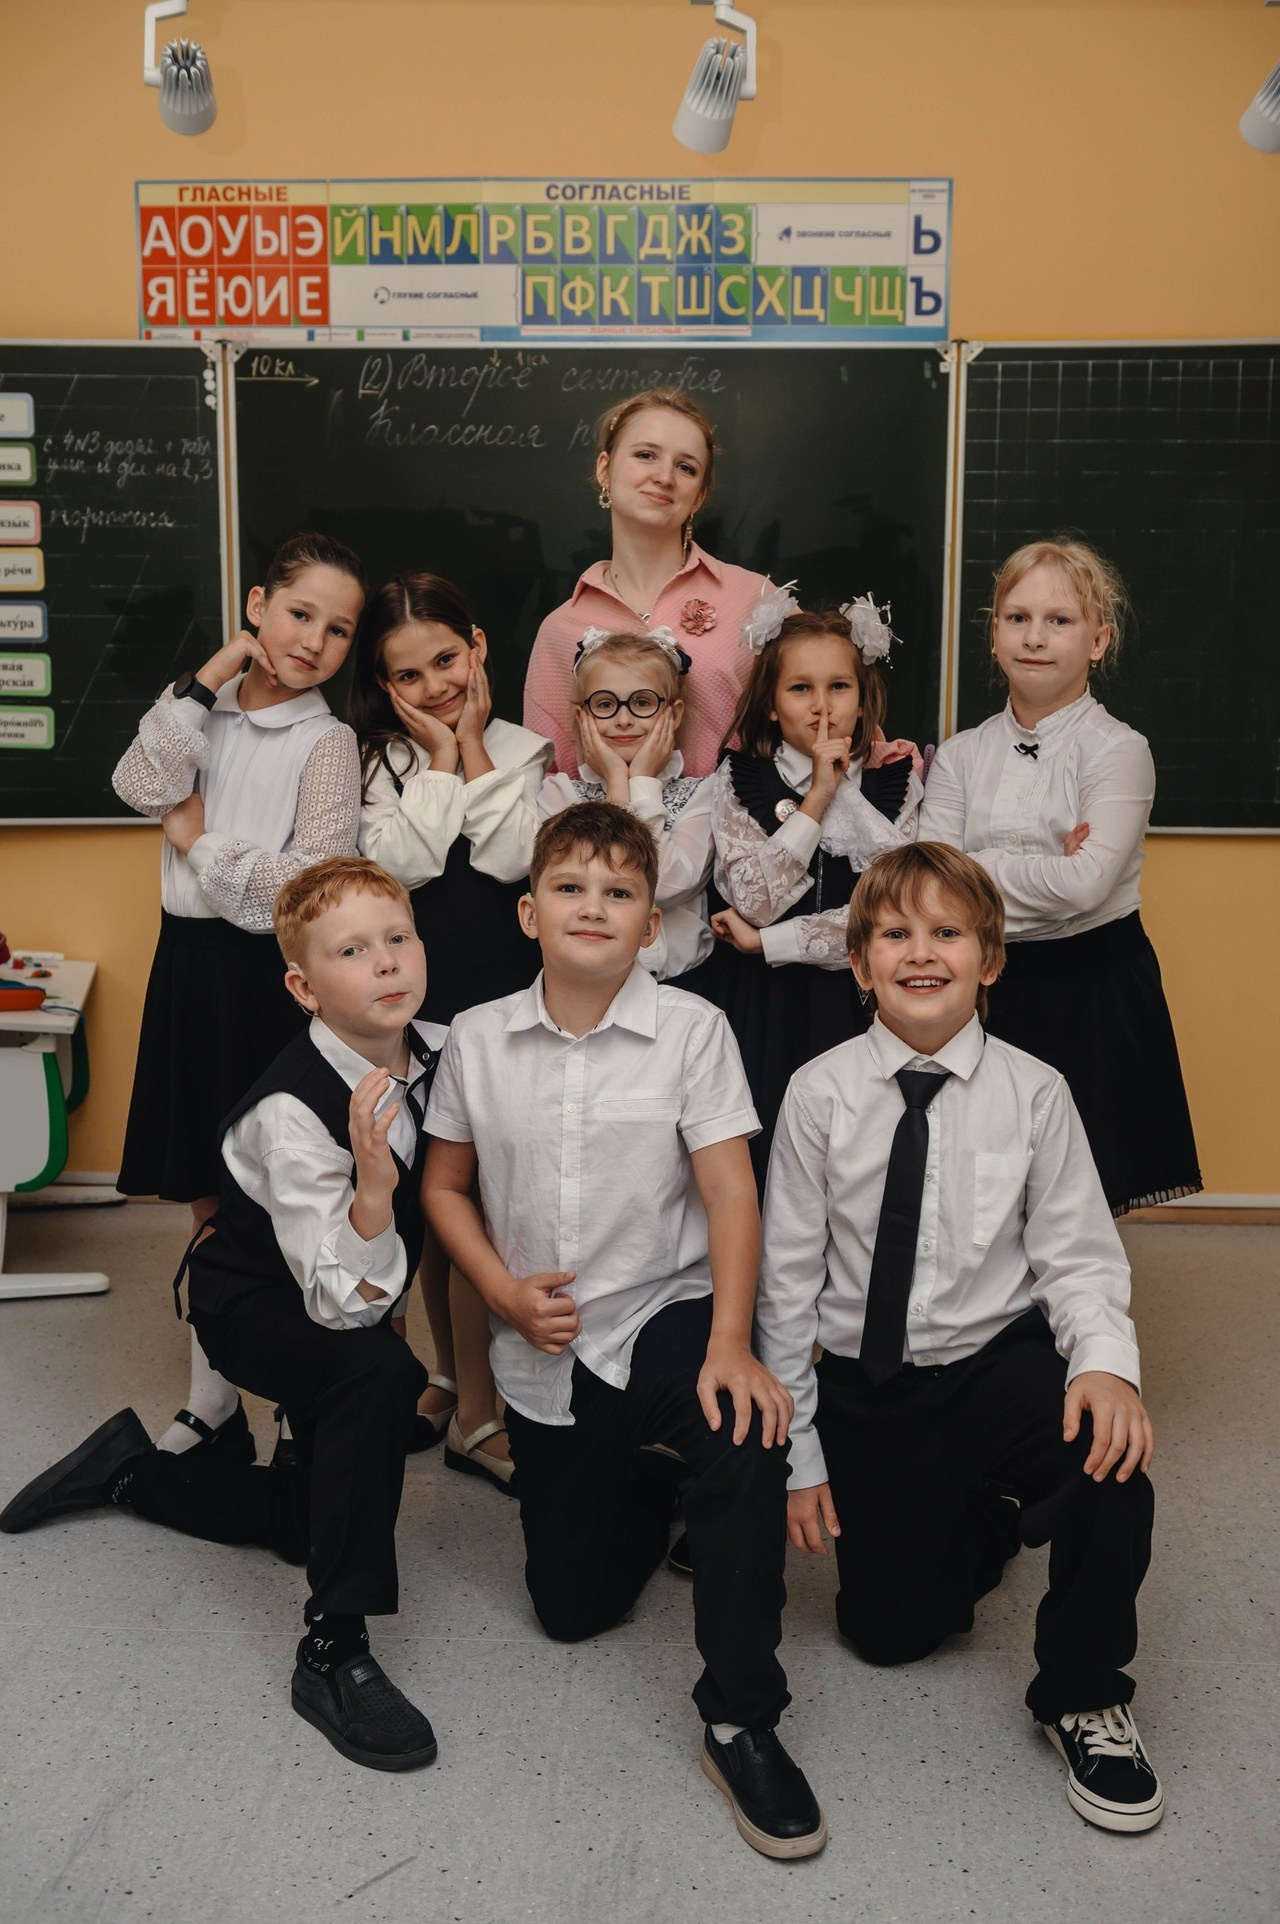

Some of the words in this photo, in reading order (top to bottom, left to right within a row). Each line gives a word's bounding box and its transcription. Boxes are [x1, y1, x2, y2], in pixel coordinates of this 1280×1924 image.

[177, 185, 289, 203] ГЛАСНЫЕ
[545, 183, 691, 201] СОГЛАСНЫЕ
[142, 215, 177, 257] А
[179, 214, 214, 258] О
[216, 214, 249, 257] У
[254, 215, 288, 257] Ы
[294, 214, 324, 257] Э
[333, 208, 365, 256] Й
[371, 214, 402, 256] Н
[406, 214, 441, 255] М
[445, 213, 479, 255] Л
[488, 214, 516, 255] Р
[526, 214, 554, 255] Б
[564, 214, 593, 255] В
[605, 214, 628, 255] Г
[638, 214, 672, 261] Д
[676, 213, 712, 255] Ж
[719, 213, 746, 256] З
[147, 276, 176, 317] Я
[186, 267, 210, 317] Ё
[216, 275, 253, 317] Ю
[256, 275, 289, 317] И
[298, 275, 322, 316] Е
[524, 275, 555, 316] П
[561, 274, 596, 317] Ф
[602, 275, 631, 316] К
[640, 275, 670, 316] Т
[676, 275, 711, 316] Ш
[717, 274, 747, 316] С
[755, 275, 786, 316] Х
[792, 275, 826, 322] Ц
[834, 275, 863, 316] Ч
[870, 275, 904, 322] Щ
[250, 354, 271, 377] 10
[397, 353, 533, 417] Второе
[365, 399, 547, 447] Классная
